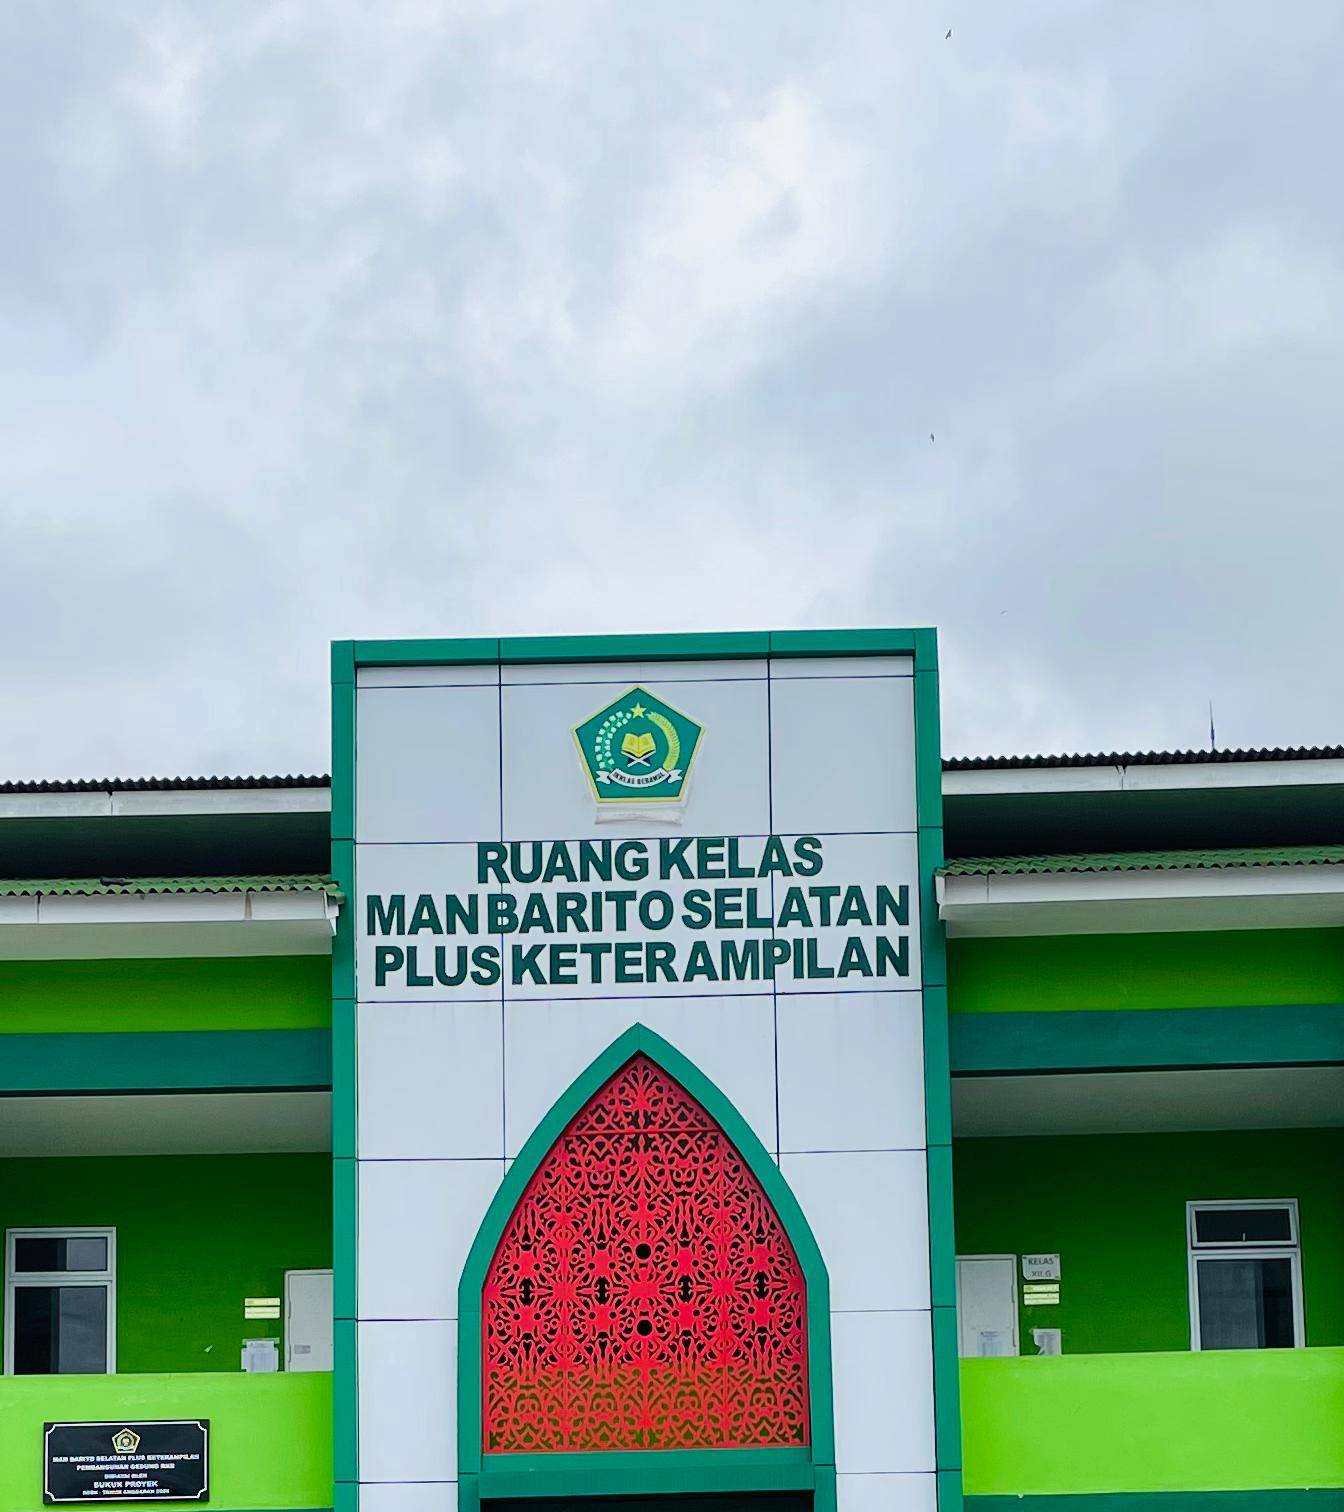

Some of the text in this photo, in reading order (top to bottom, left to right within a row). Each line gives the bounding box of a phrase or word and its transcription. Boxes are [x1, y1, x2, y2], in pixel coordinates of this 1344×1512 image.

[477, 836, 824, 884] RUANG KELAS
[367, 885, 910, 936] MAN BARITO SELATAN
[375, 936, 910, 987] PLUS KETERAMPILAN
